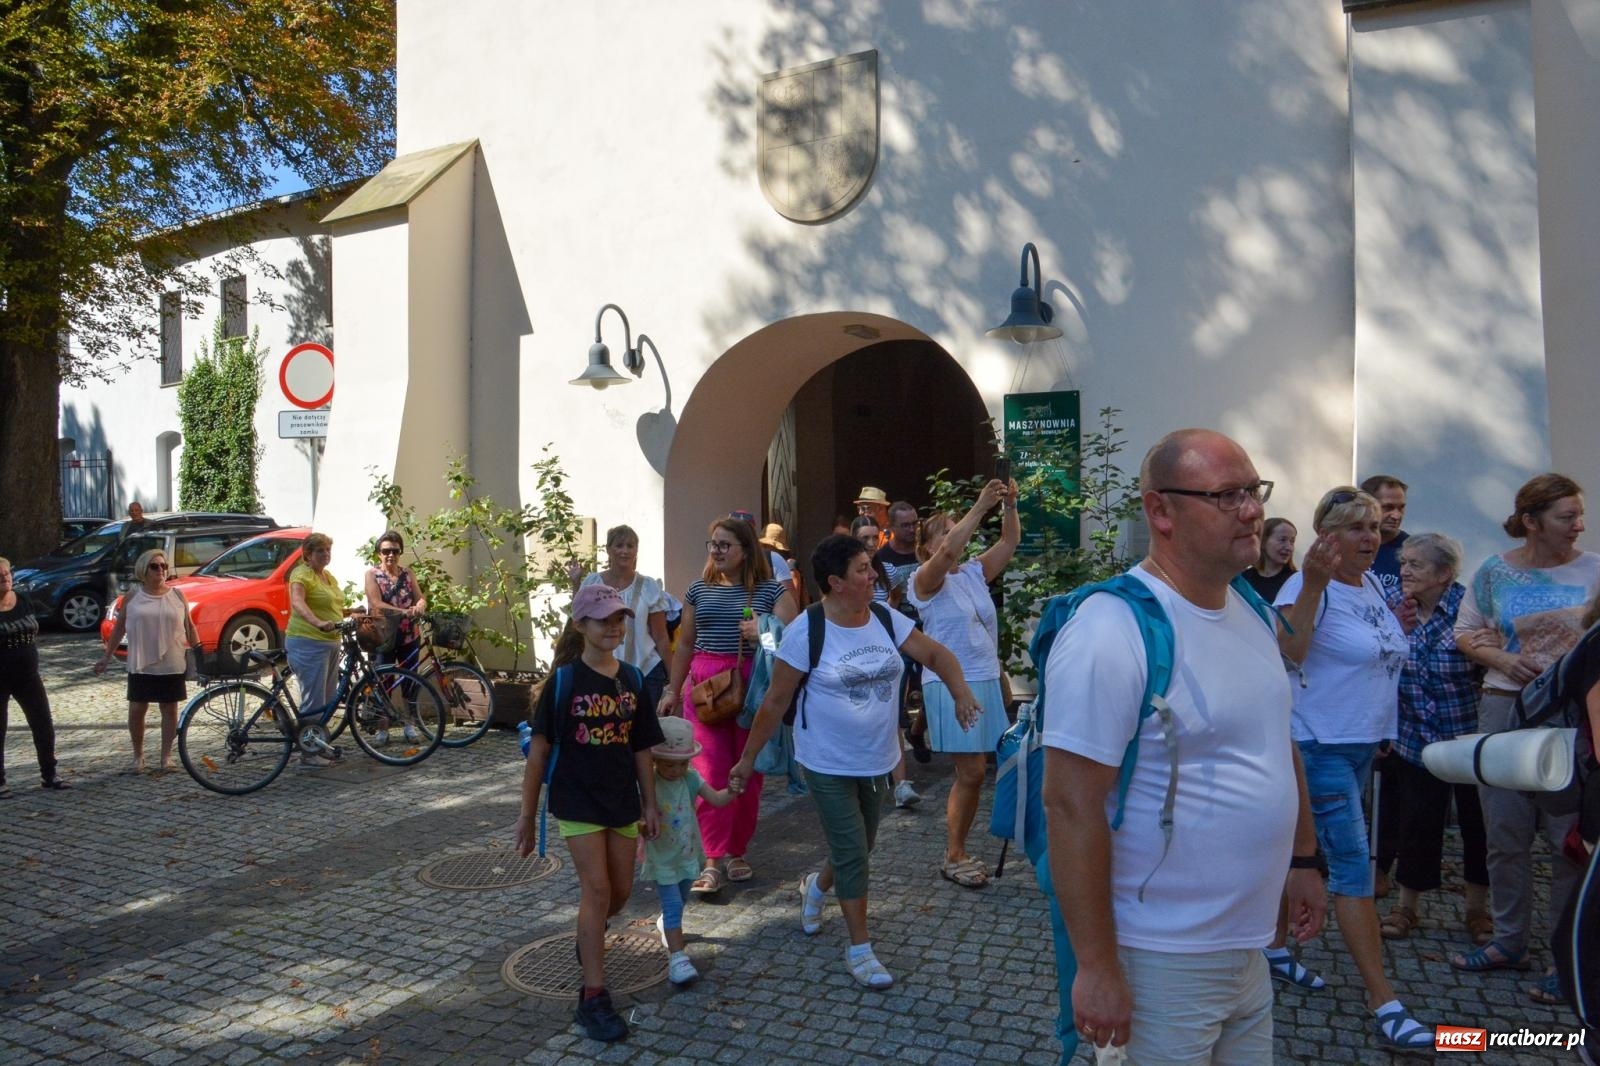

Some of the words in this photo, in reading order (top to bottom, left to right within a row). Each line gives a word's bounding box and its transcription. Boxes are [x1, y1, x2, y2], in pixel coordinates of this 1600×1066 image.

[304, 414, 326, 422] dotyczy
[1008, 418, 1076, 430] MASZYNOWNIA
[838, 645, 894, 664] TOMORROW
